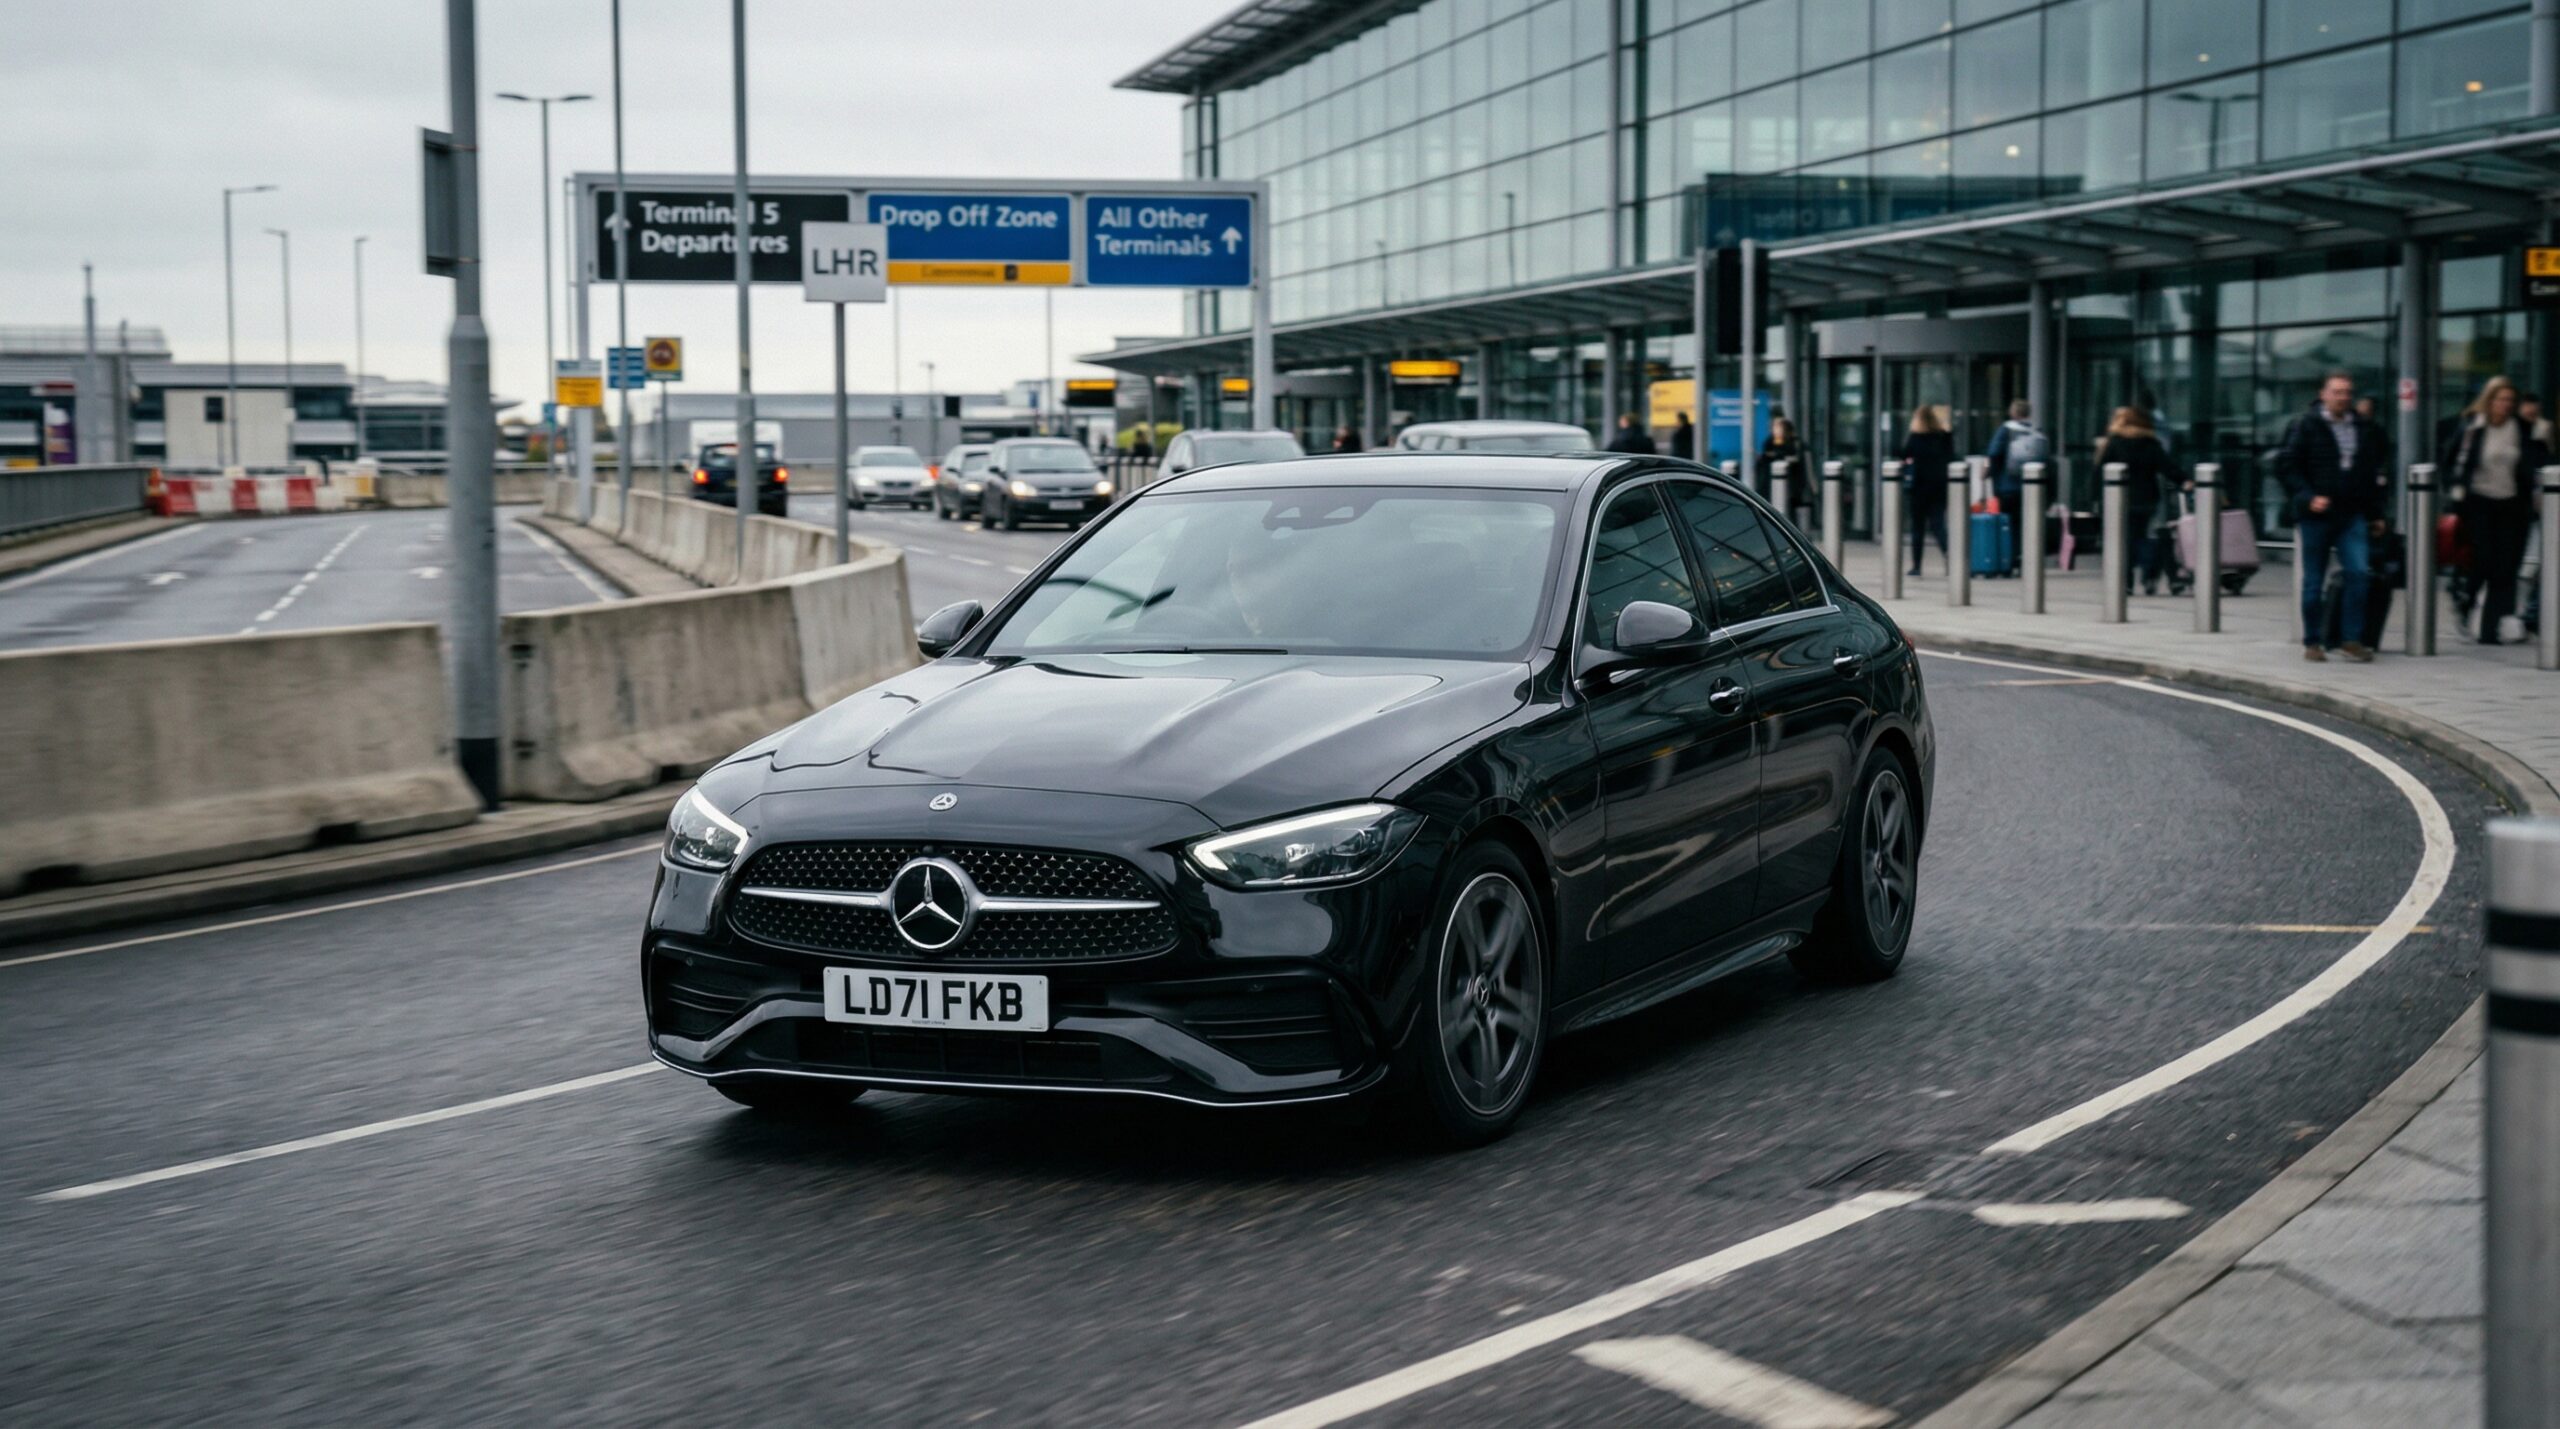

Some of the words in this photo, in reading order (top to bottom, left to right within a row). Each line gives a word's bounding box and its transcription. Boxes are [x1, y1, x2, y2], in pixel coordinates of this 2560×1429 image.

[763, 202, 780, 225] 5
[879, 205, 942, 231] Drop
[948, 204, 989, 228] Off
[996, 206, 1058, 228] Zone
[1098, 207, 1131, 229] All
[1138, 207, 1208, 230] Other
[1095, 234, 1213, 256] Terminals
[812, 249, 879, 276] LHR
[843, 974, 929, 1019] LD71
[941, 979, 1023, 1022] FKB
